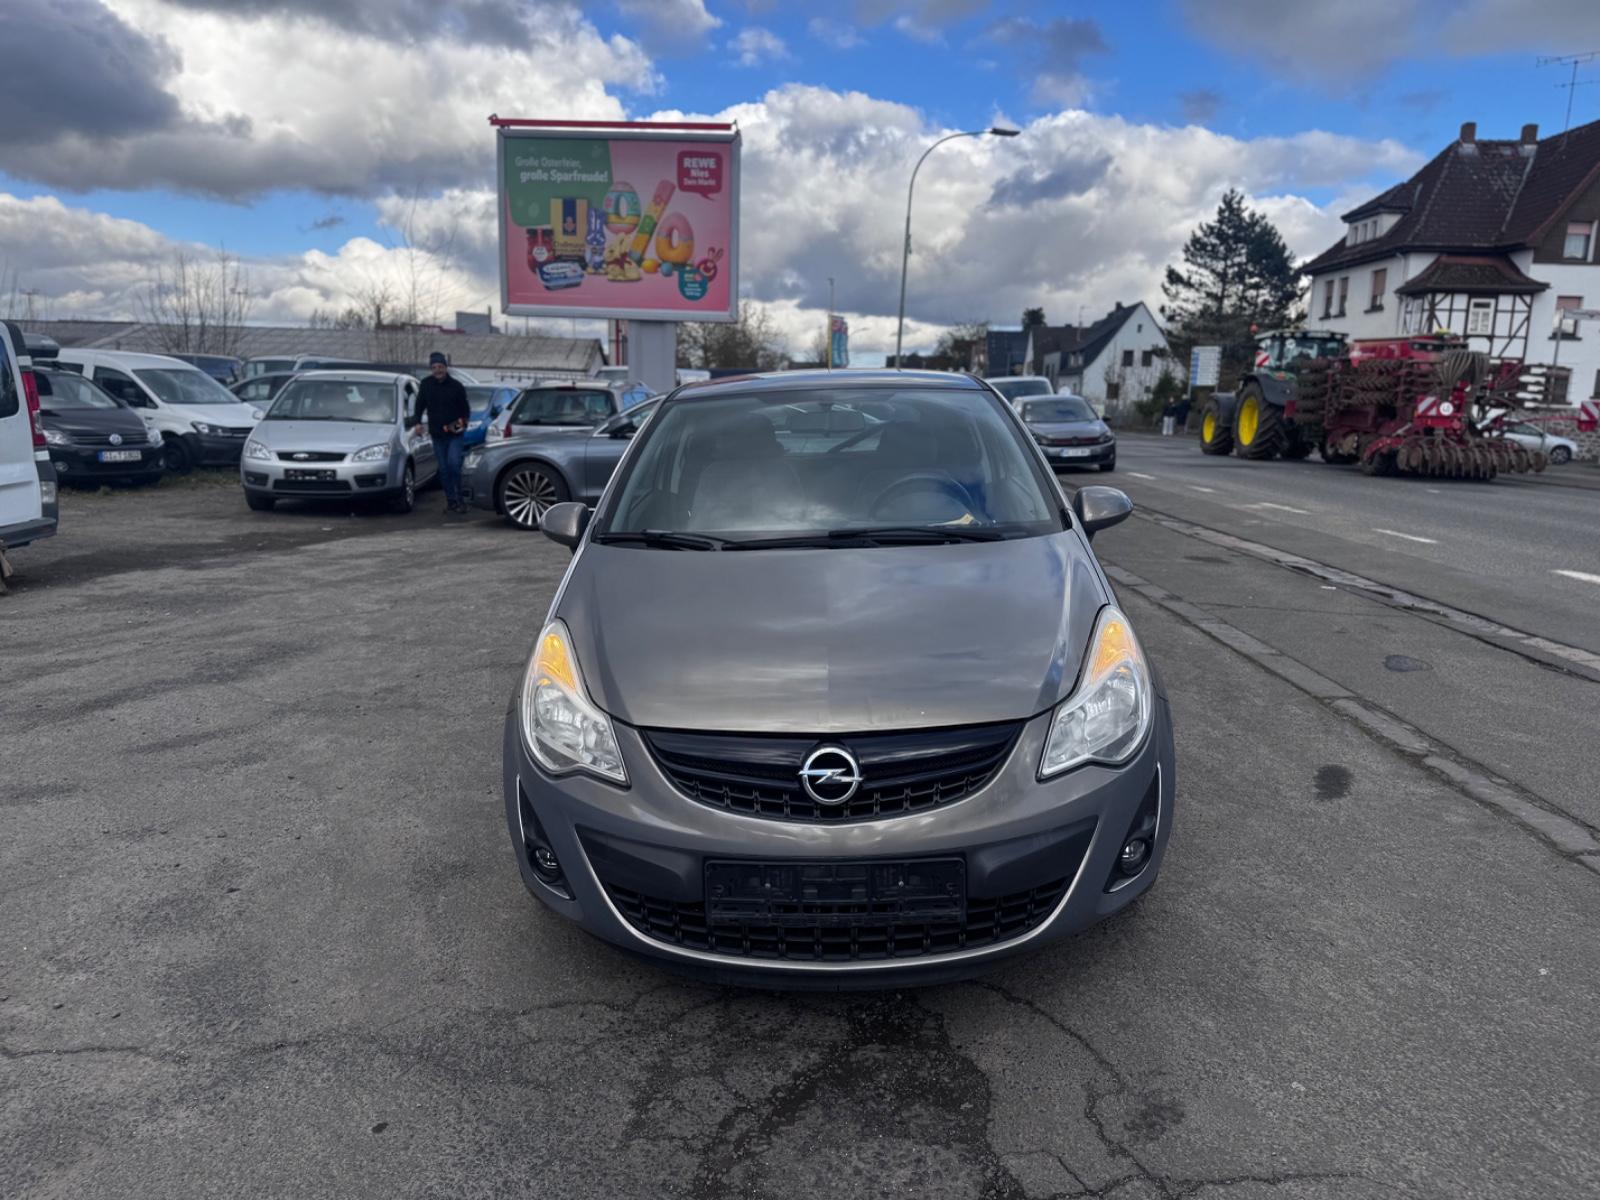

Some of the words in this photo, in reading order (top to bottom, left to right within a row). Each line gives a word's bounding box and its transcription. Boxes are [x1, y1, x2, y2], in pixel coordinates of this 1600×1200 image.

[683, 157, 717, 168] REWE
[520, 169, 549, 184] große
[550, 169, 608, 184] Sparfreude!
